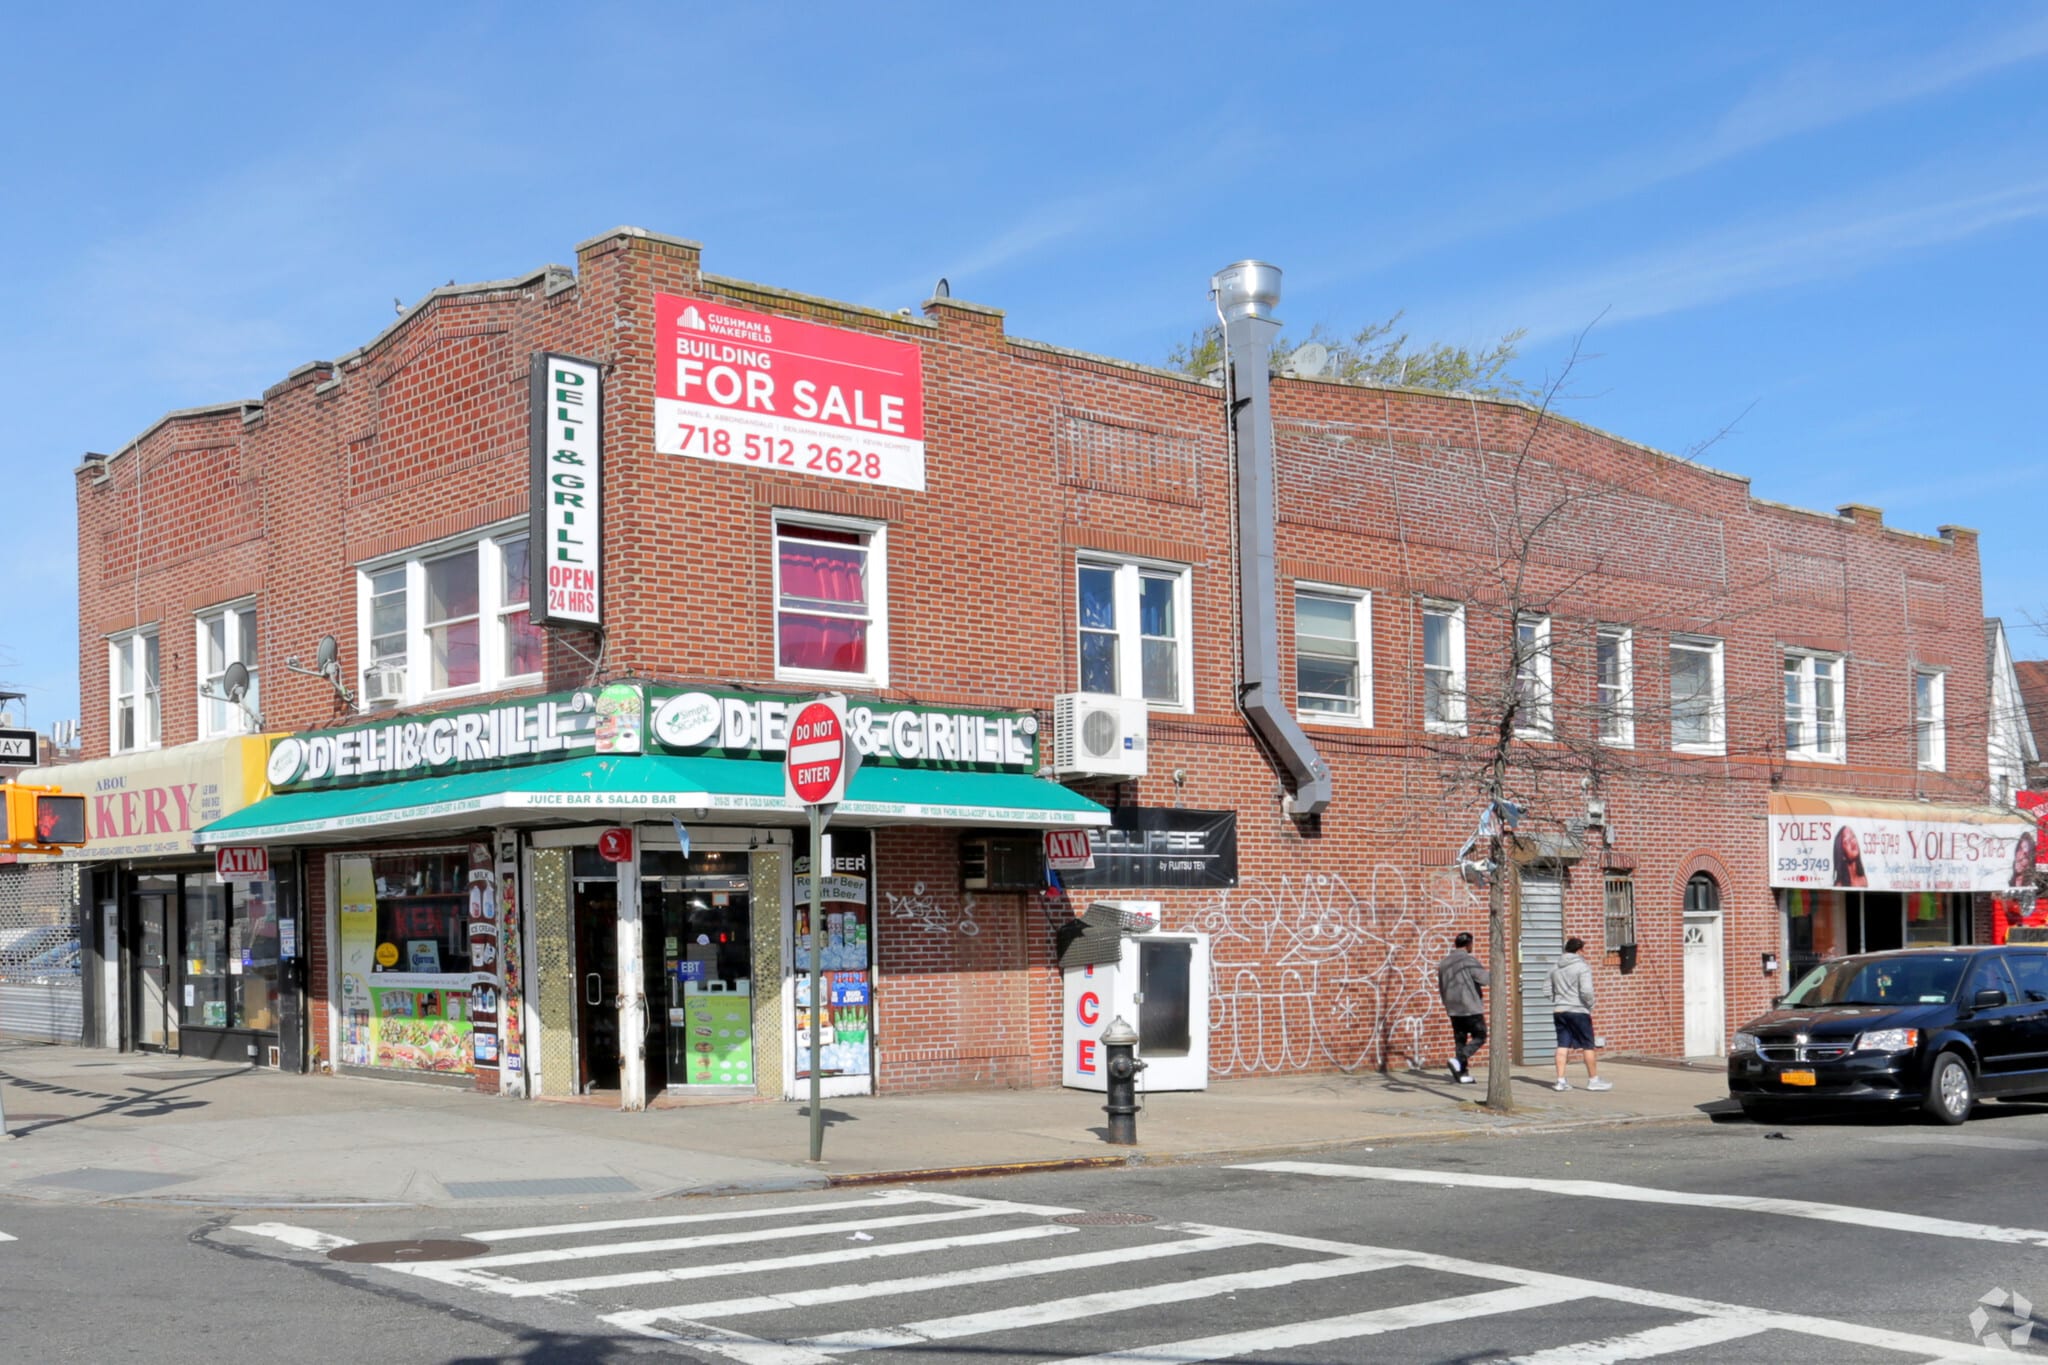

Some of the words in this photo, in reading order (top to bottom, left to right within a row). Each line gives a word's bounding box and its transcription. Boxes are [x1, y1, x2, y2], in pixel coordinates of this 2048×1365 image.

[708, 313, 764, 333] CUSHMAN
[764, 324, 772, 334] &
[708, 324, 773, 344] WAKEFIELD
[676, 337, 772, 370] BUILDING
[676, 358, 776, 412] FOR
[792, 379, 905, 434] SALE
[677, 423, 731, 456] 718
[743, 433, 795, 466] 512
[806, 443, 882, 479] 2628
[549, 565, 595, 590] OPEN
[549, 588, 566, 611] 24
[568, 591, 595, 614] HRS
[723, 698, 789, 752] DE
[851, 705, 880, 757] &
[890, 709, 1027, 767] GRILL
[796, 724, 812, 740] DO
[813, 720, 834, 739] NOT
[0, 740, 24, 755] AY
[96, 776, 128, 792] ABOU
[798, 766, 831, 786] ENTER
[527, 794, 562, 804] JUICE
[566, 794, 592, 804] BAR
[595, 794, 605, 804] &
[608, 794, 647, 804] SALAD
[651, 795, 677, 804] BAR
[1778, 821, 1832, 842] YOLE'S
[1049, 832, 1088, 858] ATM
[1906, 830, 1980, 862] YOLE'S
[220, 848, 264, 871] ATM
[1159, 860, 1168, 872] by
[1193, 861, 1205, 871] TEN
[1777, 857, 1830, 872] 539-9749
[473, 871, 489, 881] MILK
[840, 876, 864, 890] Beer
[832, 887, 857, 900] Beer
[681, 961, 700, 973] EBT
